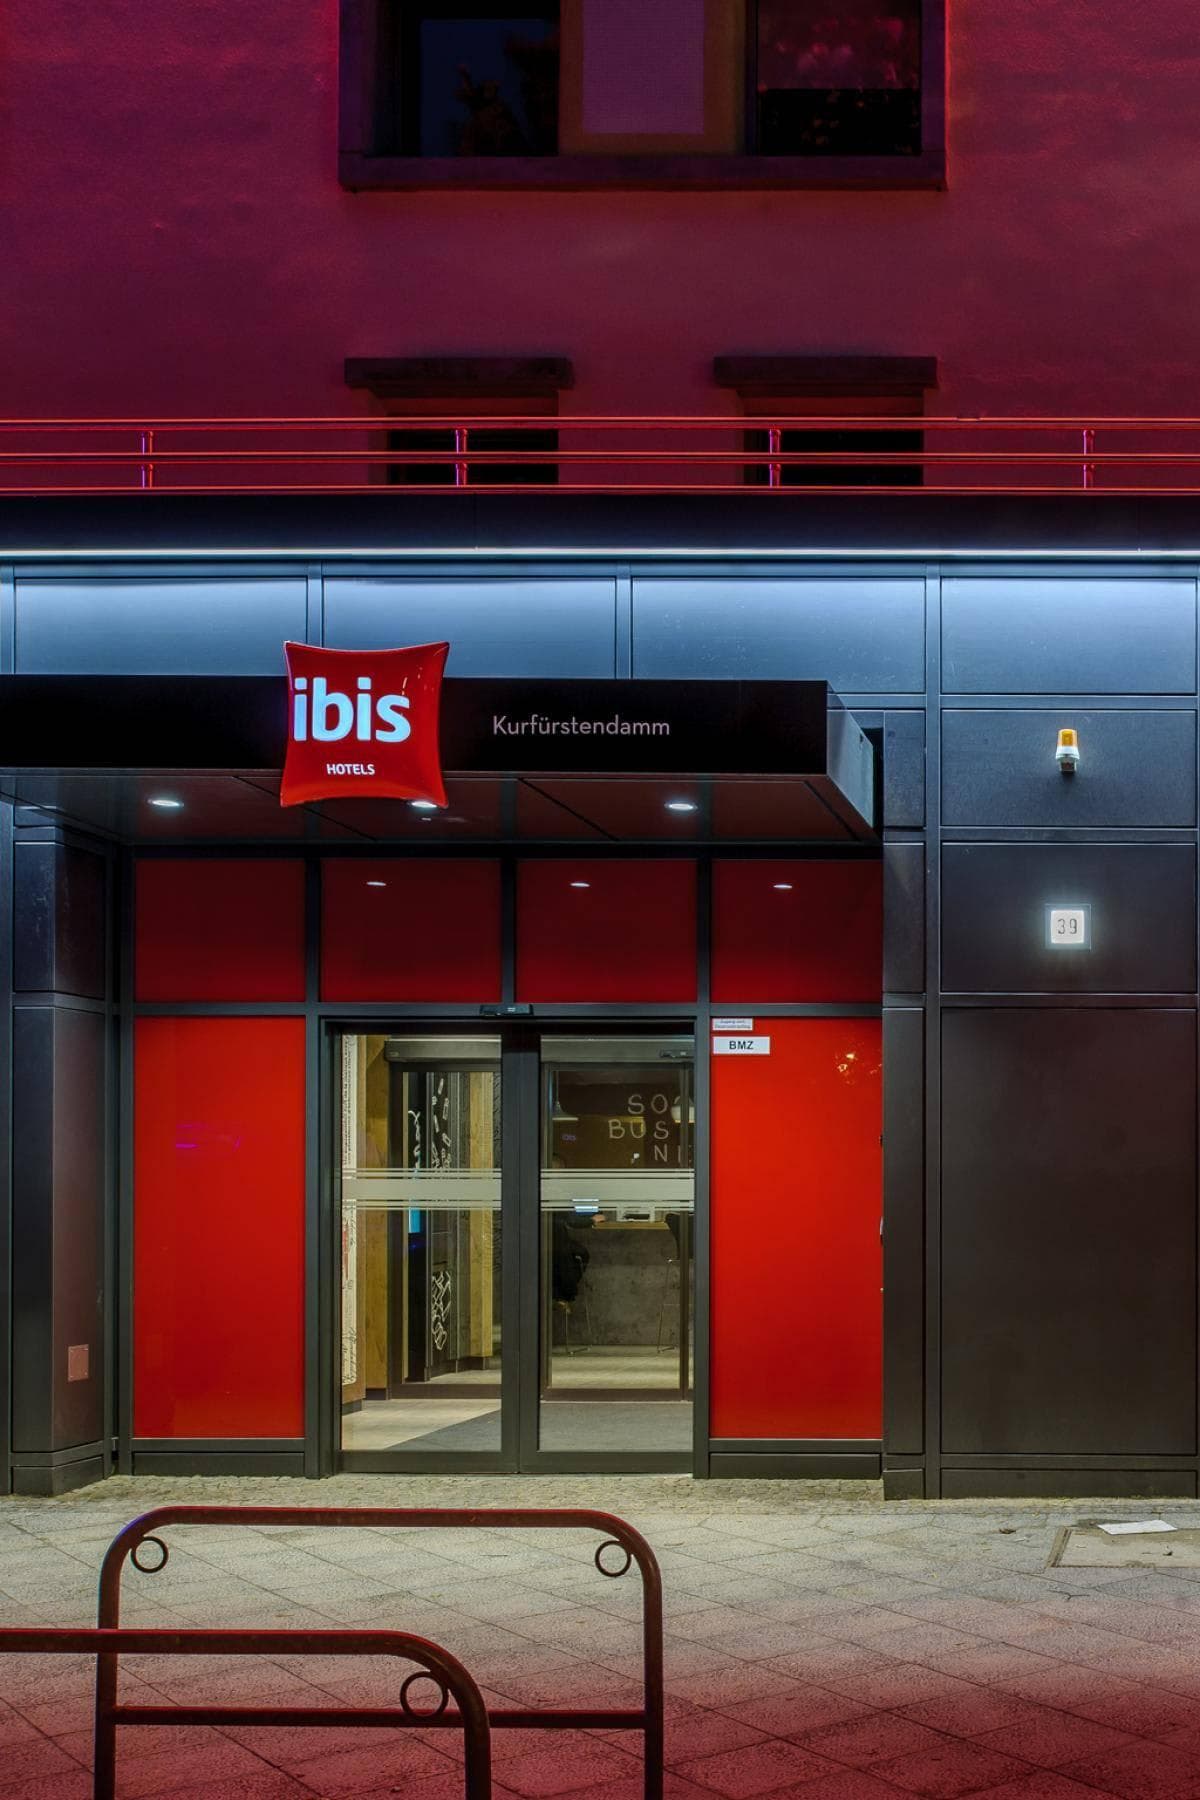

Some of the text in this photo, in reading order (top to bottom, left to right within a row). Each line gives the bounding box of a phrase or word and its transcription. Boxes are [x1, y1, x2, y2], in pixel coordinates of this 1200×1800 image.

[293, 676, 412, 743] ibis
[492, 714, 671, 737] Kurfürstendamm
[326, 763, 376, 776] HOTELS
[1057, 918, 1078, 935] 39
[729, 1040, 754, 1050] BMZ
